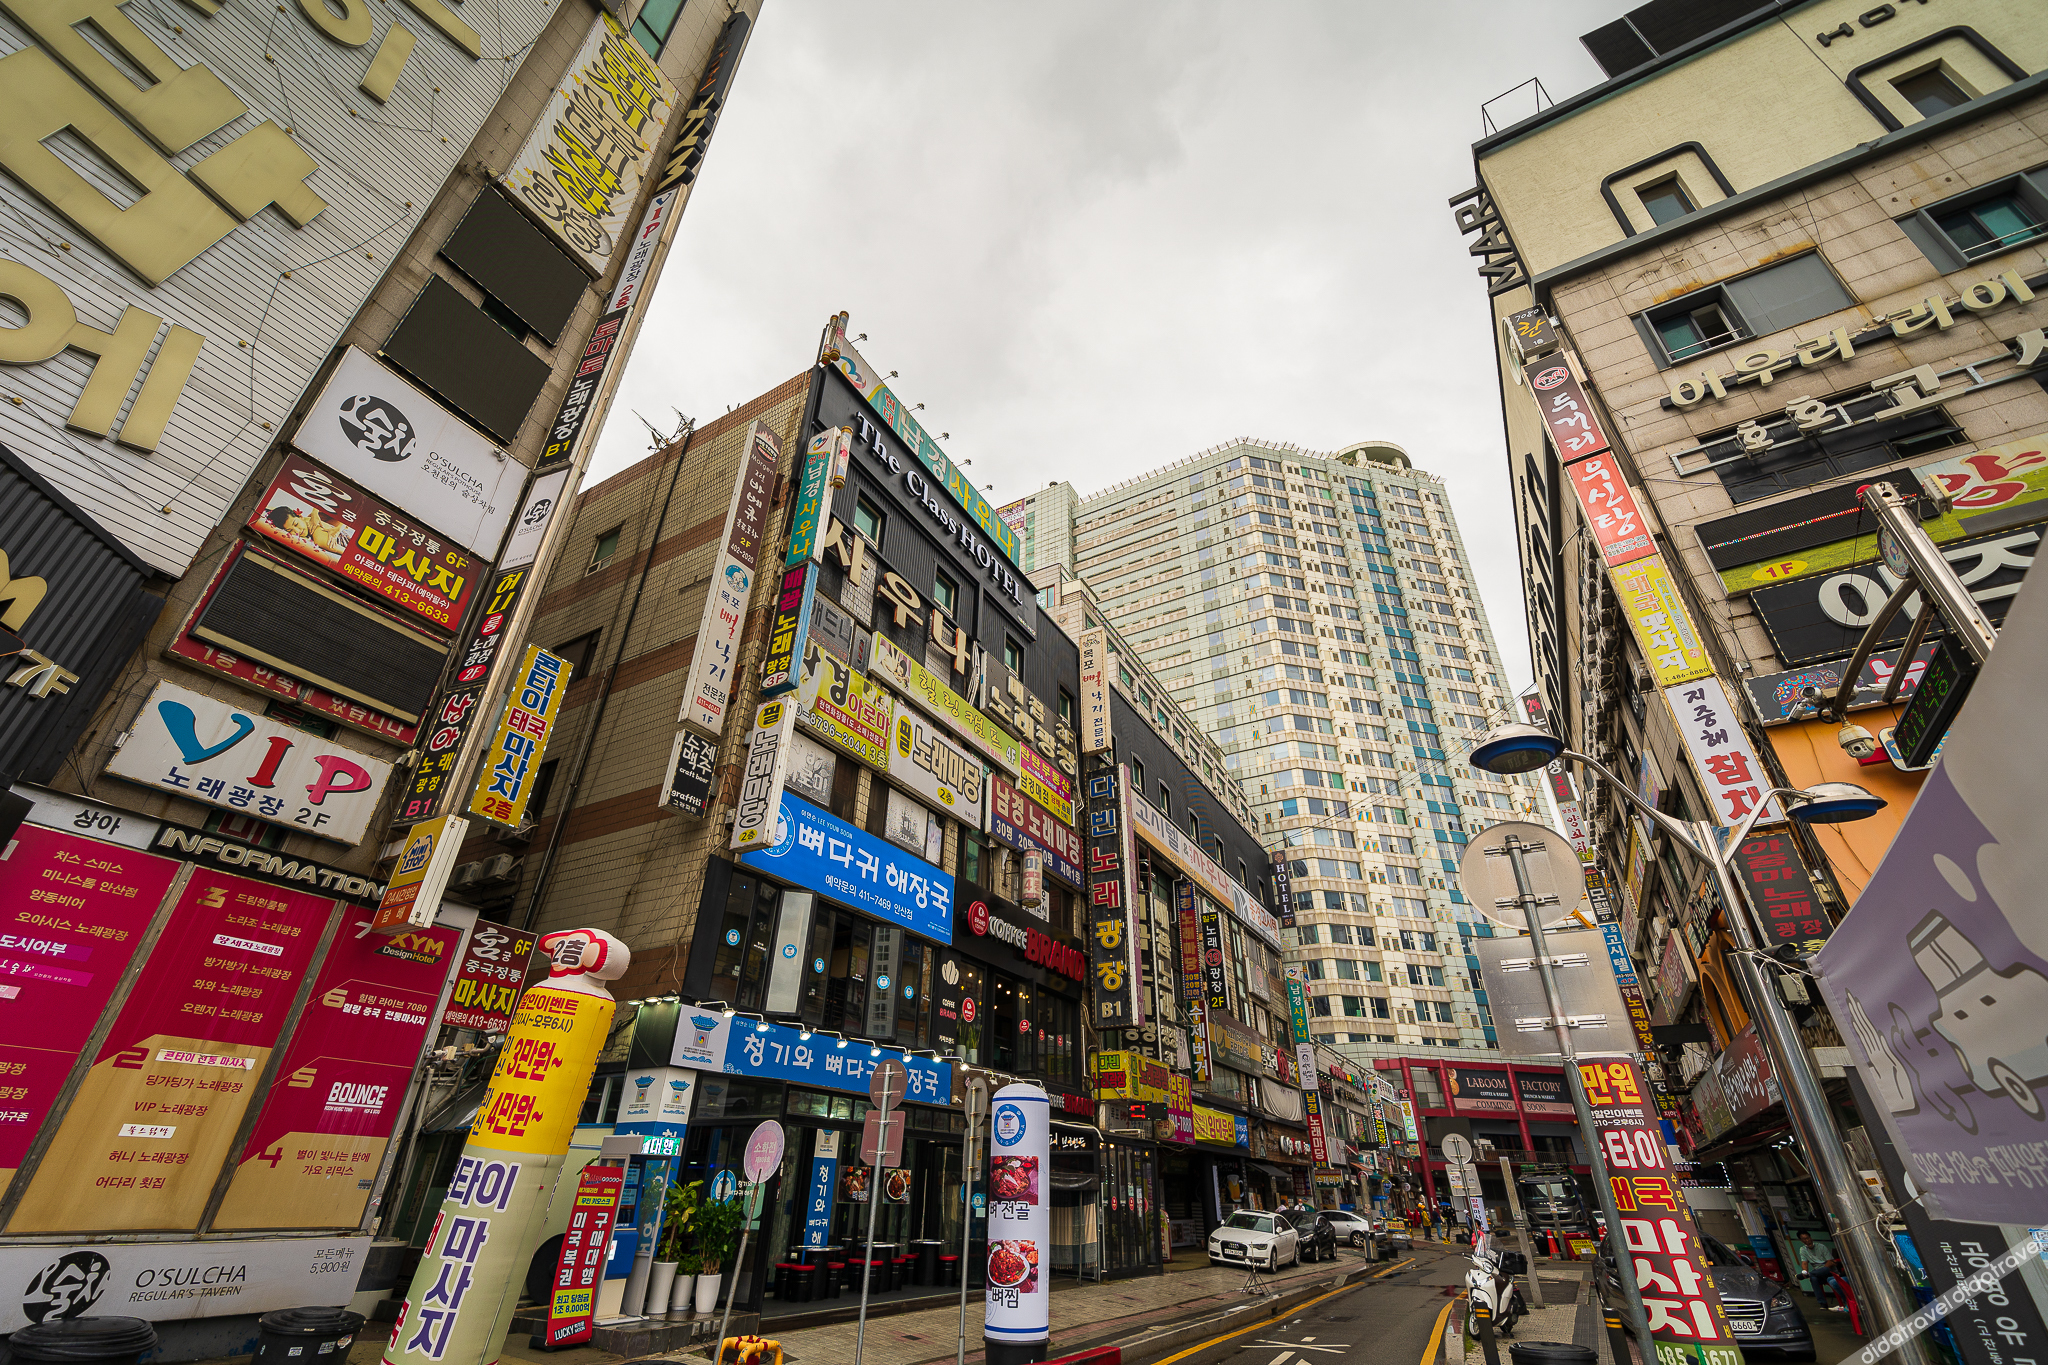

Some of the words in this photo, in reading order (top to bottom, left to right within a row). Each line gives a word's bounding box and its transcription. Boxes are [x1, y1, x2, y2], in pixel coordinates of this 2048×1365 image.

[583, 31, 665, 138] 오렌지
[520, 170, 600, 253] 3층
[643, 193, 672, 239] VIP
[576, 318, 621, 377] 토마토
[555, 379, 594, 440] 노래광장
[545, 440, 571, 458] B1
[802, 462, 823, 498] 남경
[901, 411, 949, 483] 남경
[951, 468, 1015, 560] 사우나
[855, 410, 901, 474] The
[905, 469, 958, 537] Class
[959, 523, 1025, 605] HOTEL
[373, 509, 442, 556] 중국정통
[445, 551, 470, 570] 6F
[792, 498, 819, 557] 사우나
[730, 542, 755, 566] 402-2020
[740, 537, 752, 549] 2F
[356, 525, 466, 602] 마사지
[1765, 562, 1795, 580] 1F
[343, 563, 383, 590] 예약문의
[383, 583, 450, 624] 413-6633
[487, 571, 526, 615] 허니
[780, 567, 805, 612] 배꼽
[824, 517, 971, 676] 사우나
[1637, 611, 1691, 671] 맛사지
[5, 649, 80, 699] 7F
[460, 667, 484, 682] 2F
[765, 672, 785, 687] 3F
[702, 682, 727, 704] 전문점
[506, 707, 548, 741] 태국
[702, 713, 714, 725] 1F
[763, 705, 781, 724] 필
[848, 691, 891, 738] 아로마
[918, 667, 961, 718] 힐링
[964, 710, 1003, 749] 캠프
[1005, 746, 1017, 765] 4F
[1683, 687, 1729, 748] 지중해
[899, 718, 912, 757] 필
[988, 685, 1076, 776] 노래광장
[157, 699, 373, 806] VIP
[912, 724, 981, 803] 노래마당
[487, 730, 537, 803] 마사지
[739, 731, 779, 829] 노래마당
[1704, 751, 1771, 820] 참치
[161, 765, 285, 818] 노래광장
[293, 807, 332, 829] 2F
[405, 799, 433, 817] B1
[481, 796, 514, 820] 2층
[1088, 774, 1117, 838] 다빈
[73, 808, 123, 836] 상아
[996, 780, 1025, 829] 남경
[1028, 804, 1081, 866] 노래마당
[996, 819, 1014, 841] 30명
[410, 845, 429, 859] MINI
[1135, 797, 1180, 854] 고시텔
[1192, 849, 1230, 895] 사우나
[54, 850, 81, 865] 치스
[84, 856, 124, 875] 스미스
[157, 826, 390, 901] INFORMATION
[403, 857, 425, 872] STOP
[798, 822, 880, 883] 뼈다귀
[884, 861, 951, 919] 해장국
[29, 889, 86, 910] 양동비어
[99, 881, 139, 899] 안산점
[196, 886, 229, 909] 3
[825, 873, 858, 898] 예약문의
[858, 889, 893, 912] 411-7469
[893, 902, 914, 922] 안산점
[1275, 862, 1292, 915] HOTEL
[1589, 886, 1612, 917] 모텔
[1763, 886, 1813, 919] 노래
[15, 911, 72, 931] 오아시스
[74, 922, 129, 942] 노래광장
[225, 913, 258, 929] 노라조
[260, 921, 302, 938] 노래광장
[1201, 914, 1218, 924] 일구
[1283, 917, 1294, 927] 5F
[1774, 919, 1823, 938] 광장
[387, 933, 446, 956] XYM
[514, 938, 532, 956] 6F
[551, 938, 587, 966] 2층
[1023, 926, 1086, 982] BRAND
[1180, 910, 1198, 973] 노래마당
[1607, 933, 1630, 973] 고시텔
[204, 956, 249, 974] 방가방가
[251, 961, 292, 981] 노래광장
[465, 958, 522, 983] 중국정통
[193, 979, 217, 992] 와와
[218, 983, 263, 999] 노래광장
[322, 988, 349, 1009] 6
[454, 978, 517, 1016] 마사지
[181, 1003, 218, 1017] 오렌지
[220, 1007, 263, 1023] 노래광장
[342, 1003, 361, 1015] 힐링
[362, 1006, 380, 1018] 중국
[358, 993, 378, 1006] 힐링
[379, 997, 406, 1009] 라이브
[406, 1000, 428, 1012] 7080
[1101, 1000, 1122, 1019] B1
[1210, 996, 1226, 1009] 2F
[468, 1011, 507, 1032] 413-6633
[1293, 1006, 1308, 1040] 사우나
[1626, 996, 1654, 1045] 노래광장
[742, 1032, 815, 1071] 청기와
[1188, 1004, 1210, 1077] 수제버거
[112, 1047, 150, 1070] 2
[146, 1075, 195, 1089] 딩가딩가
[197, 1077, 243, 1093] 노래광장
[327, 1081, 389, 1105] BOUNCE
[1465, 1076, 1508, 1090] LABOOM
[1519, 1079, 1562, 1093] FACTORY
[134, 1101, 157, 1112] VIP
[158, 1103, 208, 1117] 노래광장
[1305, 1091, 1319, 1114] 남경
[1475, 1100, 1513, 1111] COMMING
[1525, 1102, 1548, 1112] SOON
[1207, 1116, 1236, 1143] 임대문의
[1308, 1115, 1327, 1161] 노래마당
[1403, 1116, 1418, 1141] PC
[108, 1151, 137, 1163] 허니
[139, 1151, 189, 1165] 노래광장
[257, 1146, 283, 1168] 4
[297, 1149, 317, 1161] 별이
[320, 1150, 349, 1162] 빛나는
[351, 1152, 371, 1163] 밤에
[96, 1177, 137, 1189] 어다리
[301, 1164, 323, 1176] 가요
[325, 1165, 354, 1177] 리믹스
[814, 1164, 830, 1214] 청기와
[1001, 1201, 1032, 1222] 전골
[313, 1247, 355, 1260] 모든메뉴
[135, 1265, 248, 1288] O'SULCHA
[309, 1259, 351, 1275] 5,900원
[1621, 1217, 1721, 1341] 마사지
[128, 1288, 194, 1303] REGULAR'S
[200, 1285, 242, 1299] TAVERN
[405, 1215, 492, 1363] 마사지
[990, 1287, 1021, 1310] 뼈찜
[554, 1326, 576, 1342] LUCKY
